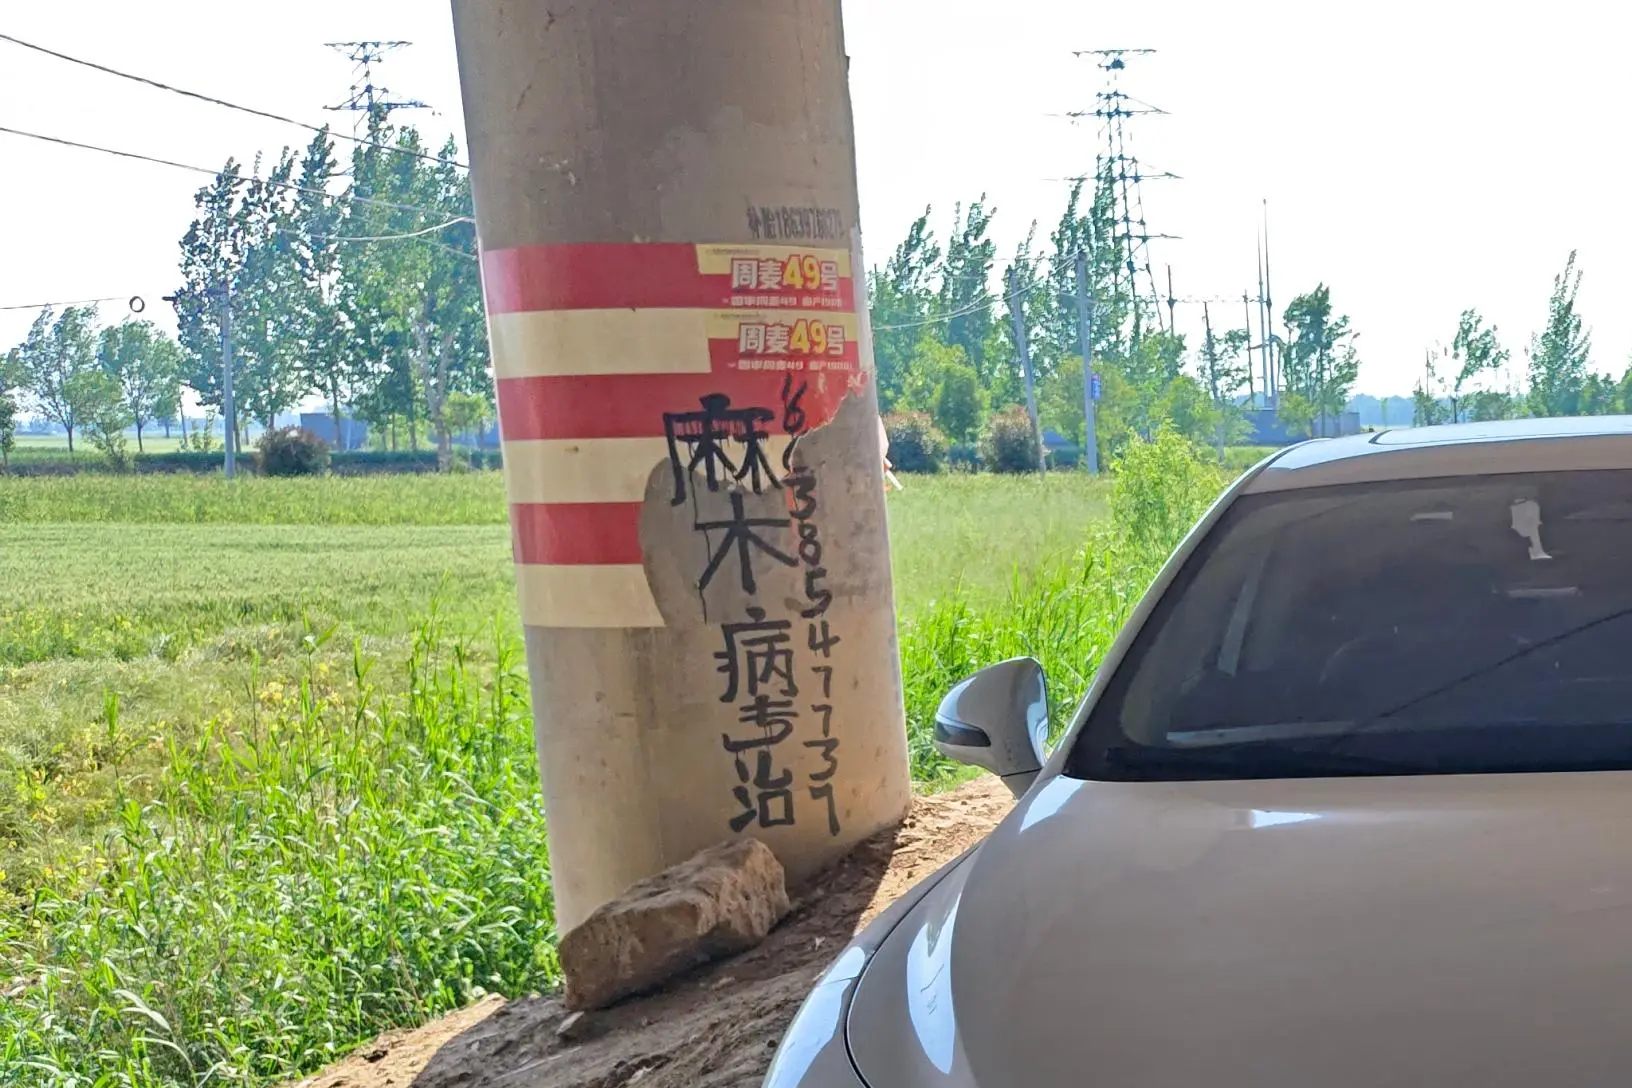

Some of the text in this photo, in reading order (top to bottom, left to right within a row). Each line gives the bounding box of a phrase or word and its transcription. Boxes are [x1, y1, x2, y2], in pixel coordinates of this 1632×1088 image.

[731, 254, 838, 291] 周麦49号
[739, 319, 845, 355] 周麦49号
